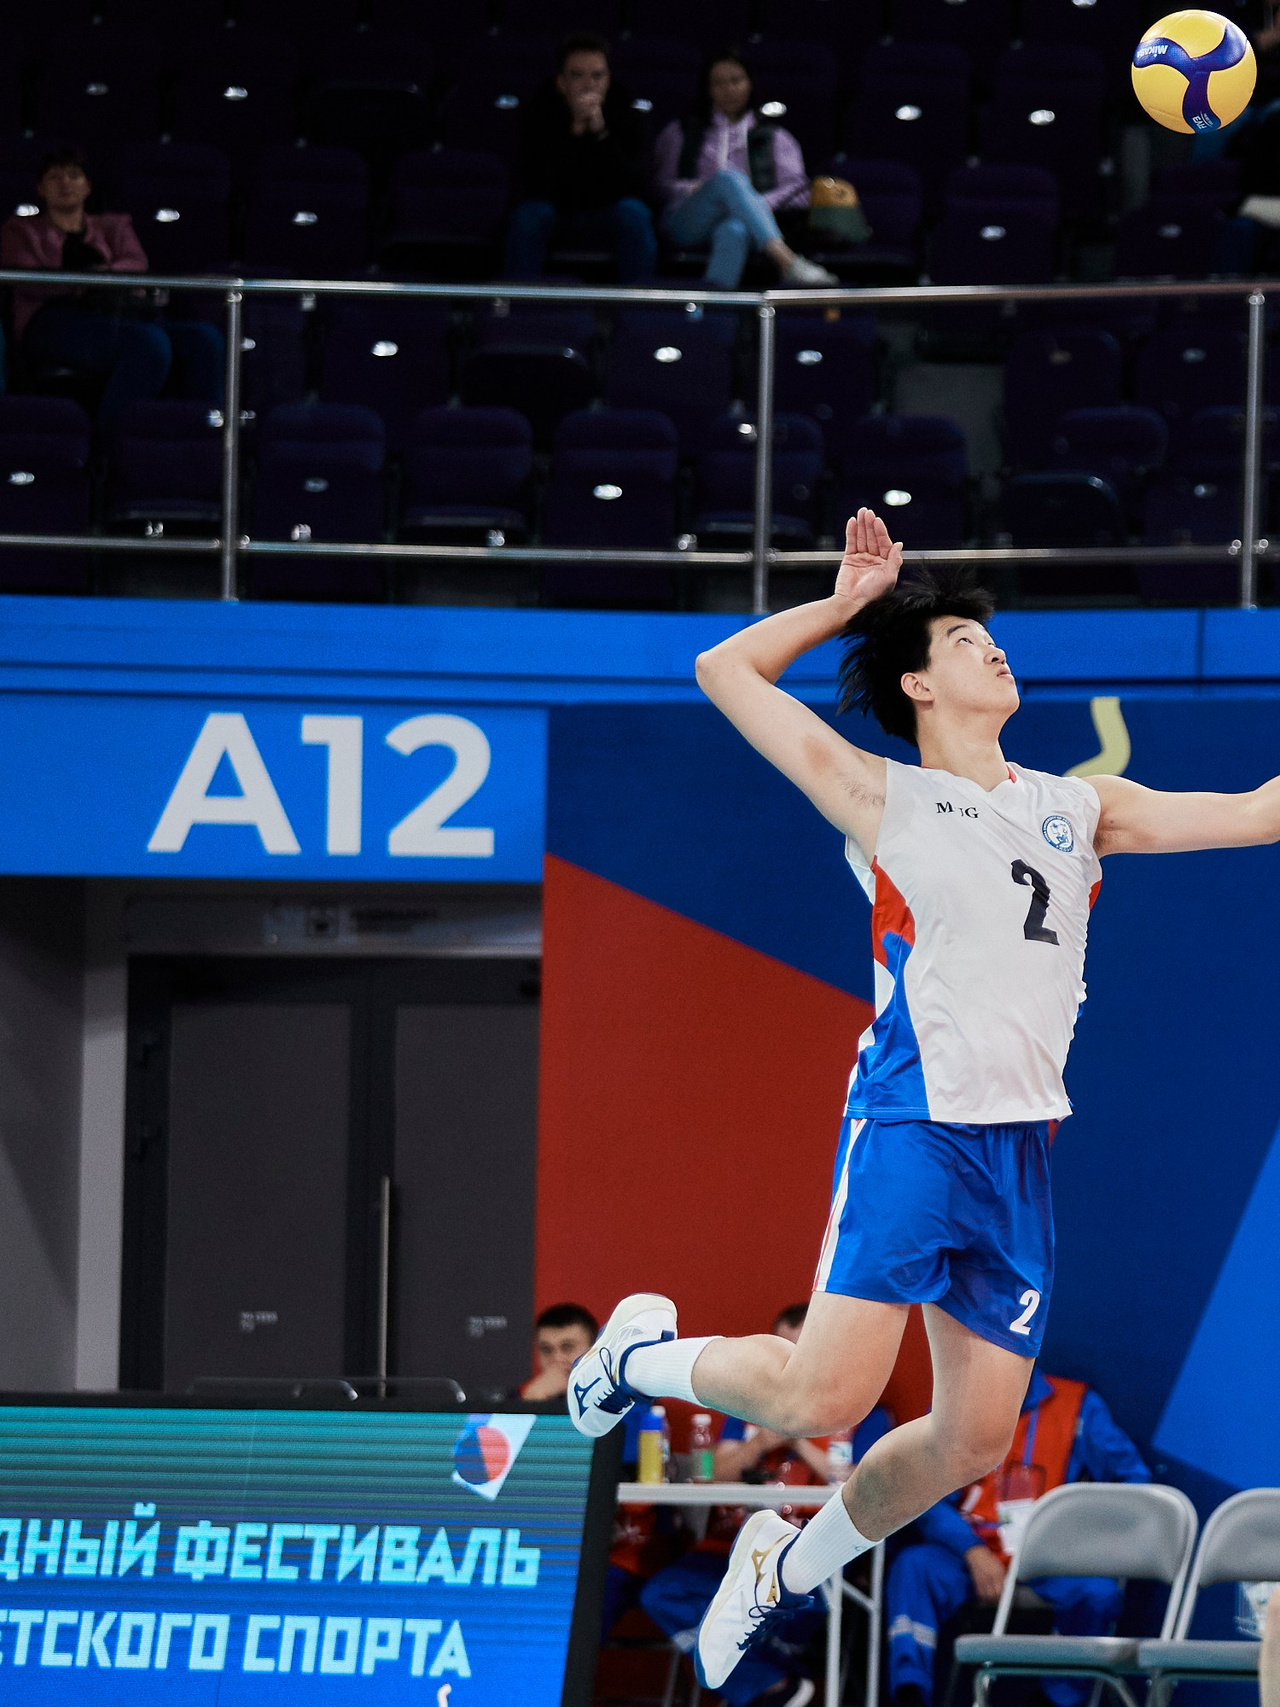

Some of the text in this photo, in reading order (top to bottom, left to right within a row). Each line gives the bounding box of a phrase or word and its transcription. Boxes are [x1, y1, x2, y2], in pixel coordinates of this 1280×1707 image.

[147, 712, 495, 858] A12
[935, 801, 979, 819] MG
[1010, 858, 1060, 946] 2
[1009, 1289, 1041, 1336] 2
[174, 1519, 541, 1587] ФЕСТИВАЛЬ
[0, 1608, 472, 1678] ТСКОГО СПОРТА
